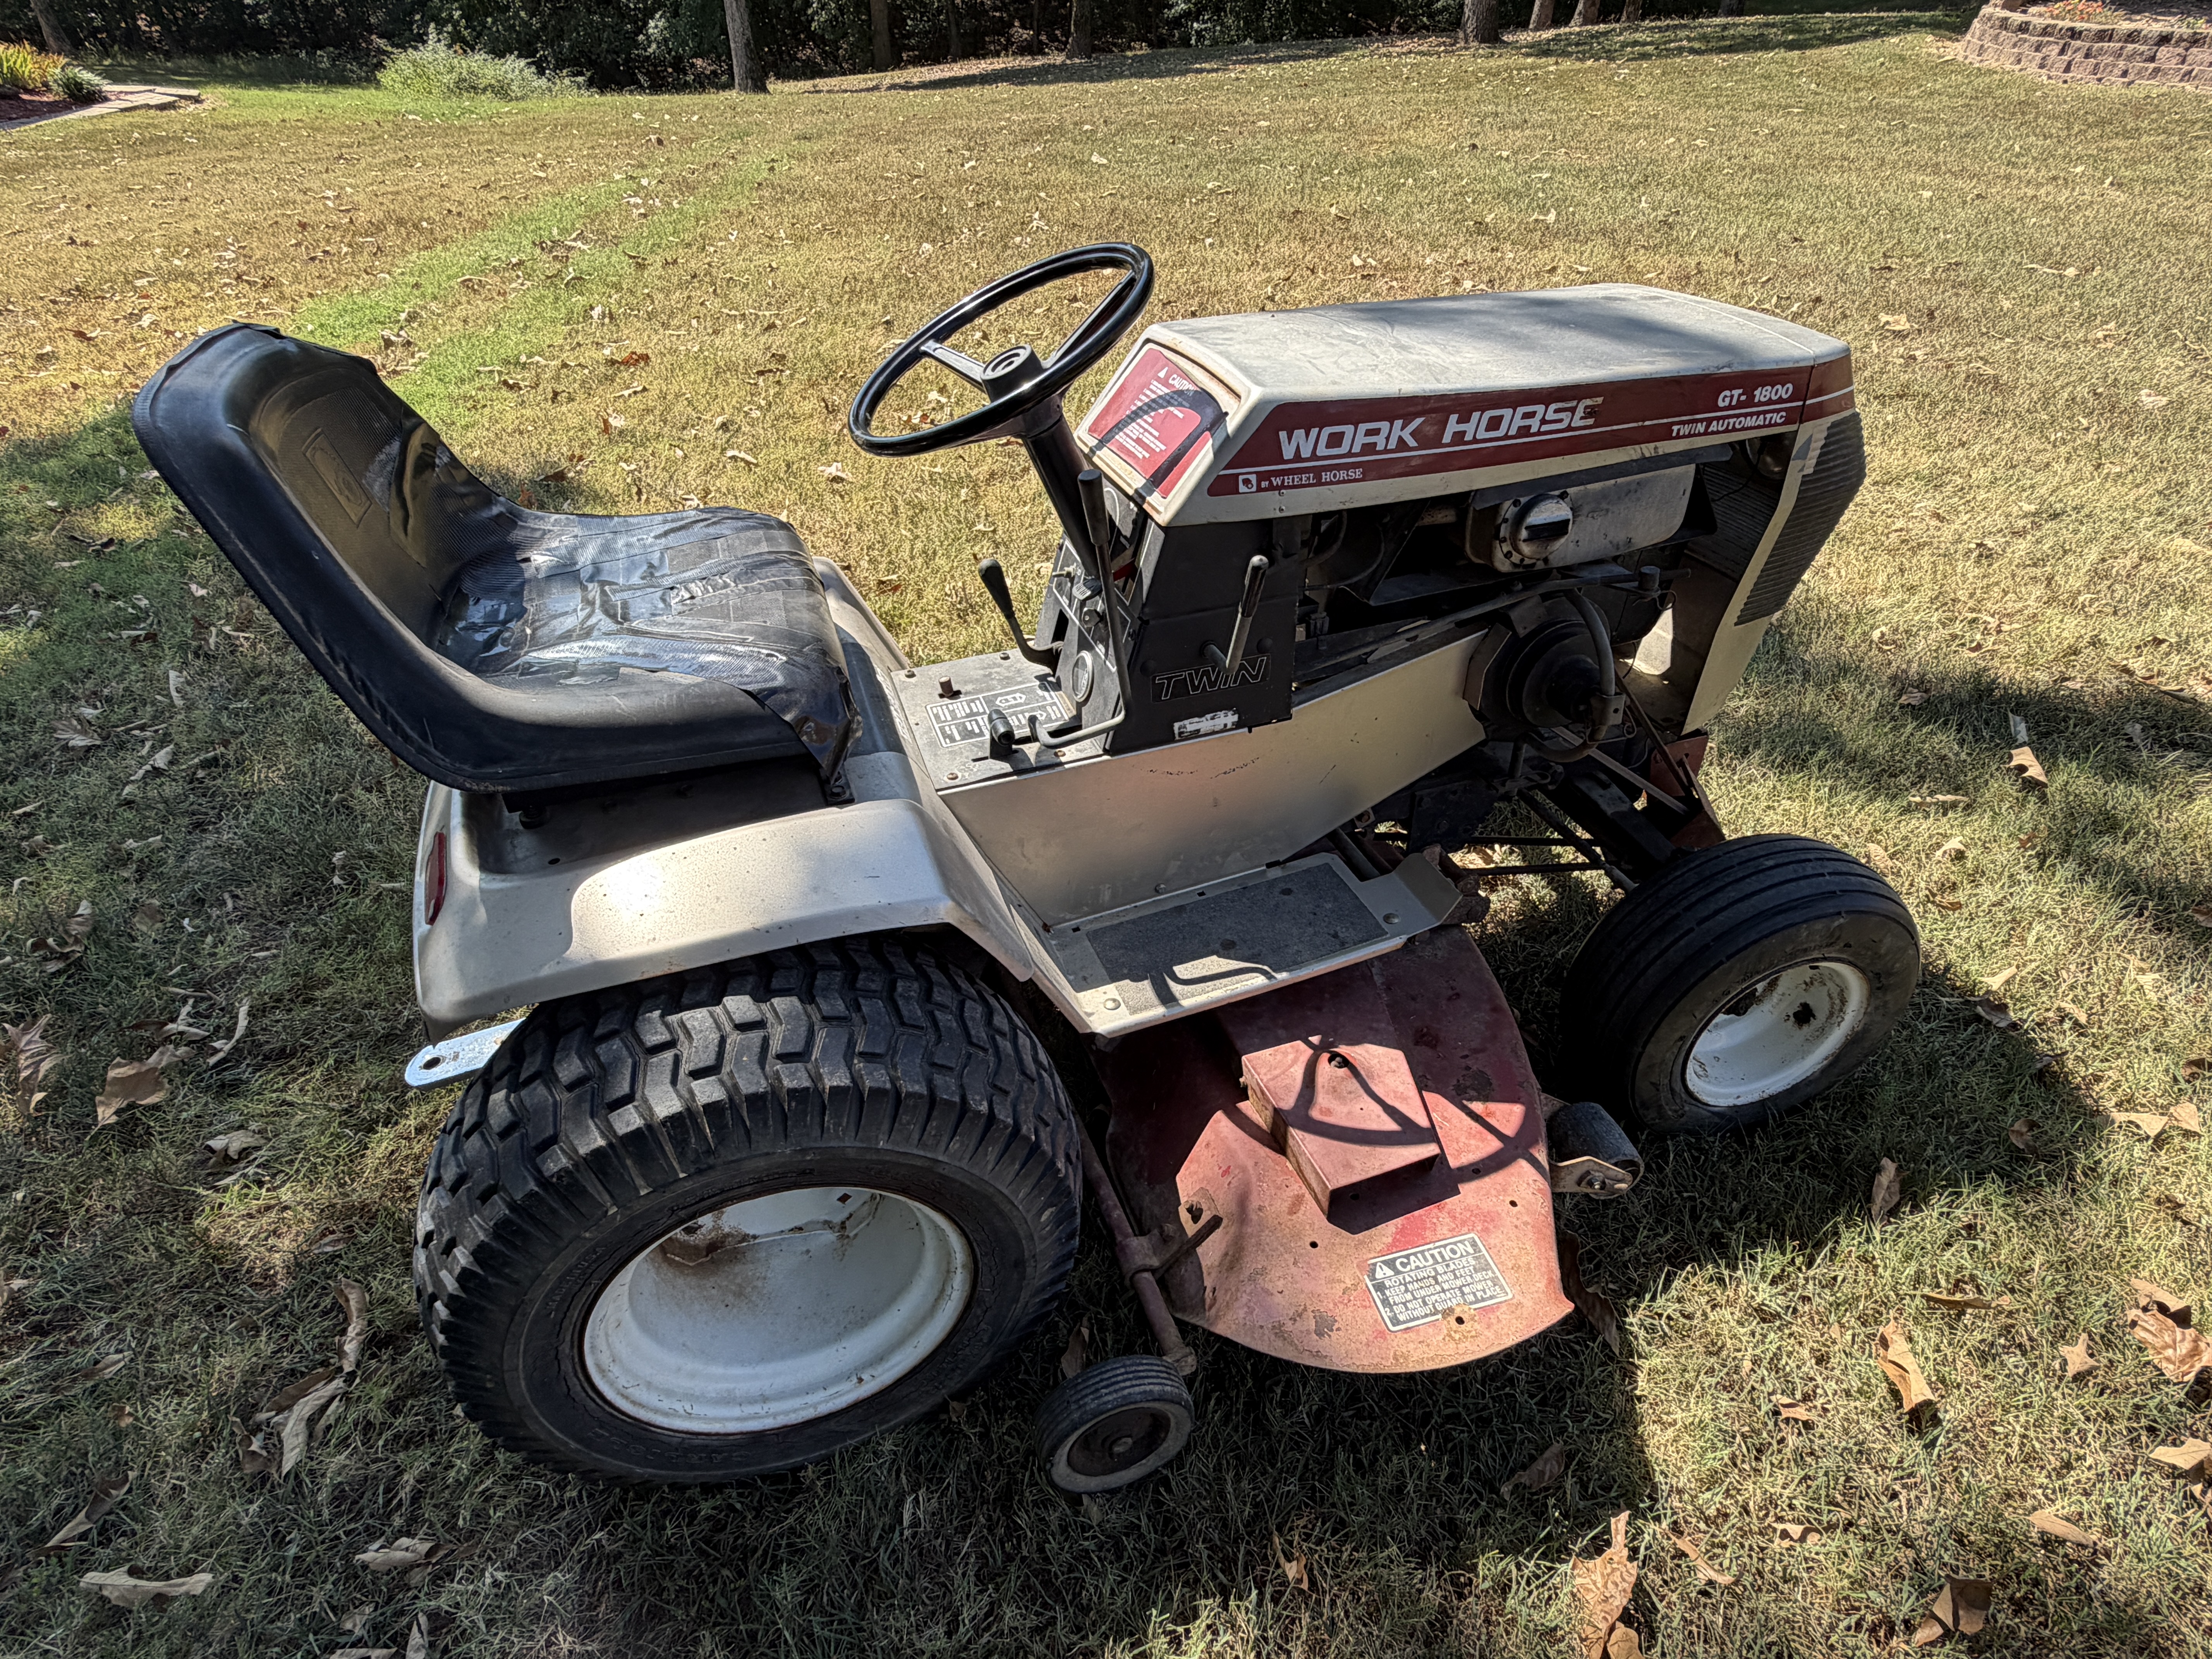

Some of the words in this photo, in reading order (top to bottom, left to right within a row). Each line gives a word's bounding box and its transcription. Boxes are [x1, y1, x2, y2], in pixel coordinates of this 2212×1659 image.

[1168, 374, 1194, 396] CAUTION
[1753, 383, 1793, 403] 1800
[1279, 417, 1426, 460] WORK
[1442, 397, 1604, 443] HORSE
[1671, 421, 1706, 436] TWIN
[1708, 412, 1786, 432] AUTOMATIC
[1271, 473, 1316, 486] WHEEL
[1322, 468, 1362, 482] HORSE
[1156, 657, 1267, 700] TWIN
[1396, 1241, 1475, 1272] CAUTION
[1384, 1268, 1435, 1288] ROTATING
[1436, 1257, 1475, 1274] BLADES
[1384, 1285, 1405, 1297] KEEP
[1407, 1278, 1435, 1291] HANDS
[1437, 1272, 1454, 1283] AND
[1455, 1266, 1475, 1277] FEET
[1389, 1292, 1413, 1305] FROM
[1413, 1285, 1442, 1298] UNDER
[1442, 1276, 1473, 1290] MOWER
[1393, 1304, 1405, 1314] DO
[1407, 1299, 1424, 1310] NOT
[1425, 1288, 1462, 1304] OPERATE
[1462, 1280, 1494, 1294] MOWER
[1397, 1304, 1433, 1321] WITHOUT
[1435, 1297, 1463, 1310] GUARD
[1464, 1294, 1475, 1303] IN
